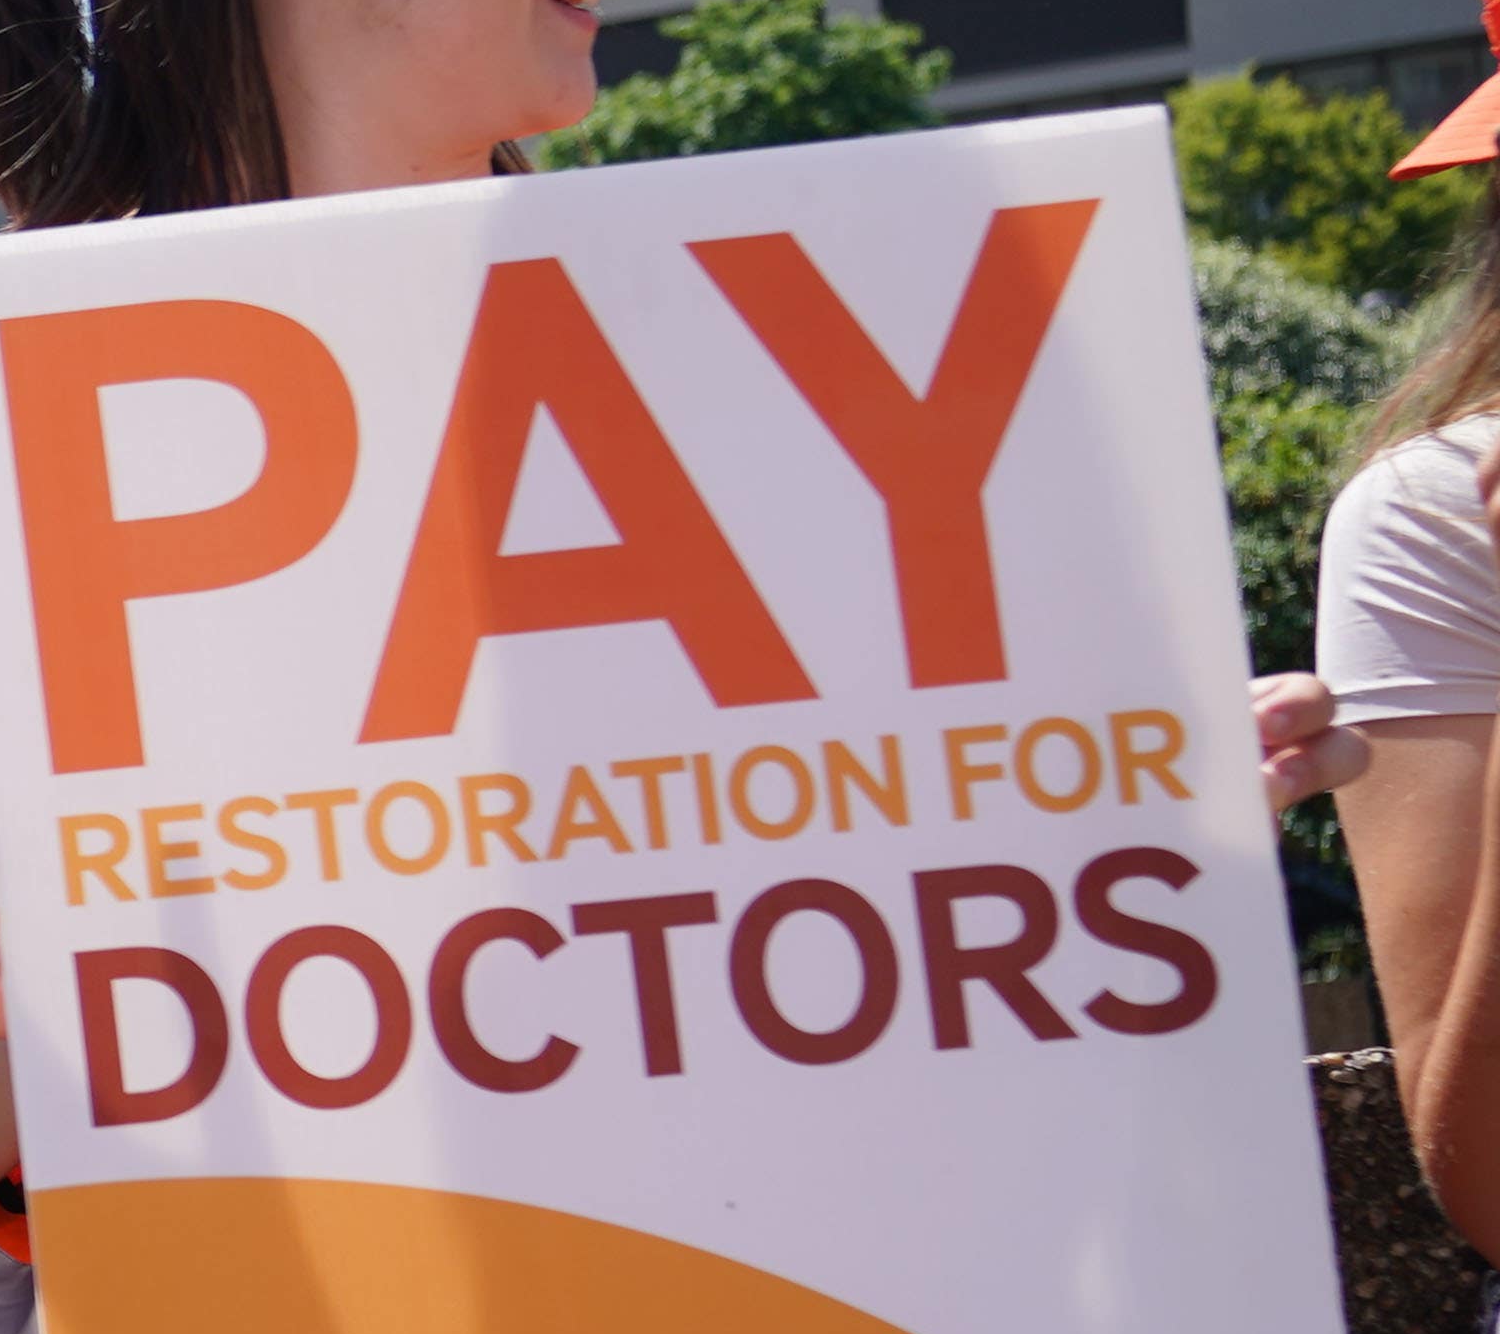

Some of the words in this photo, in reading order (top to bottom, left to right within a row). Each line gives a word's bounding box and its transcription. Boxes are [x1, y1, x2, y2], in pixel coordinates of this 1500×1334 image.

[58, 733, 911, 904] RESTORATION
[948, 711, 1192, 817] FOR
[73, 847, 1220, 1128] DOCTORS
